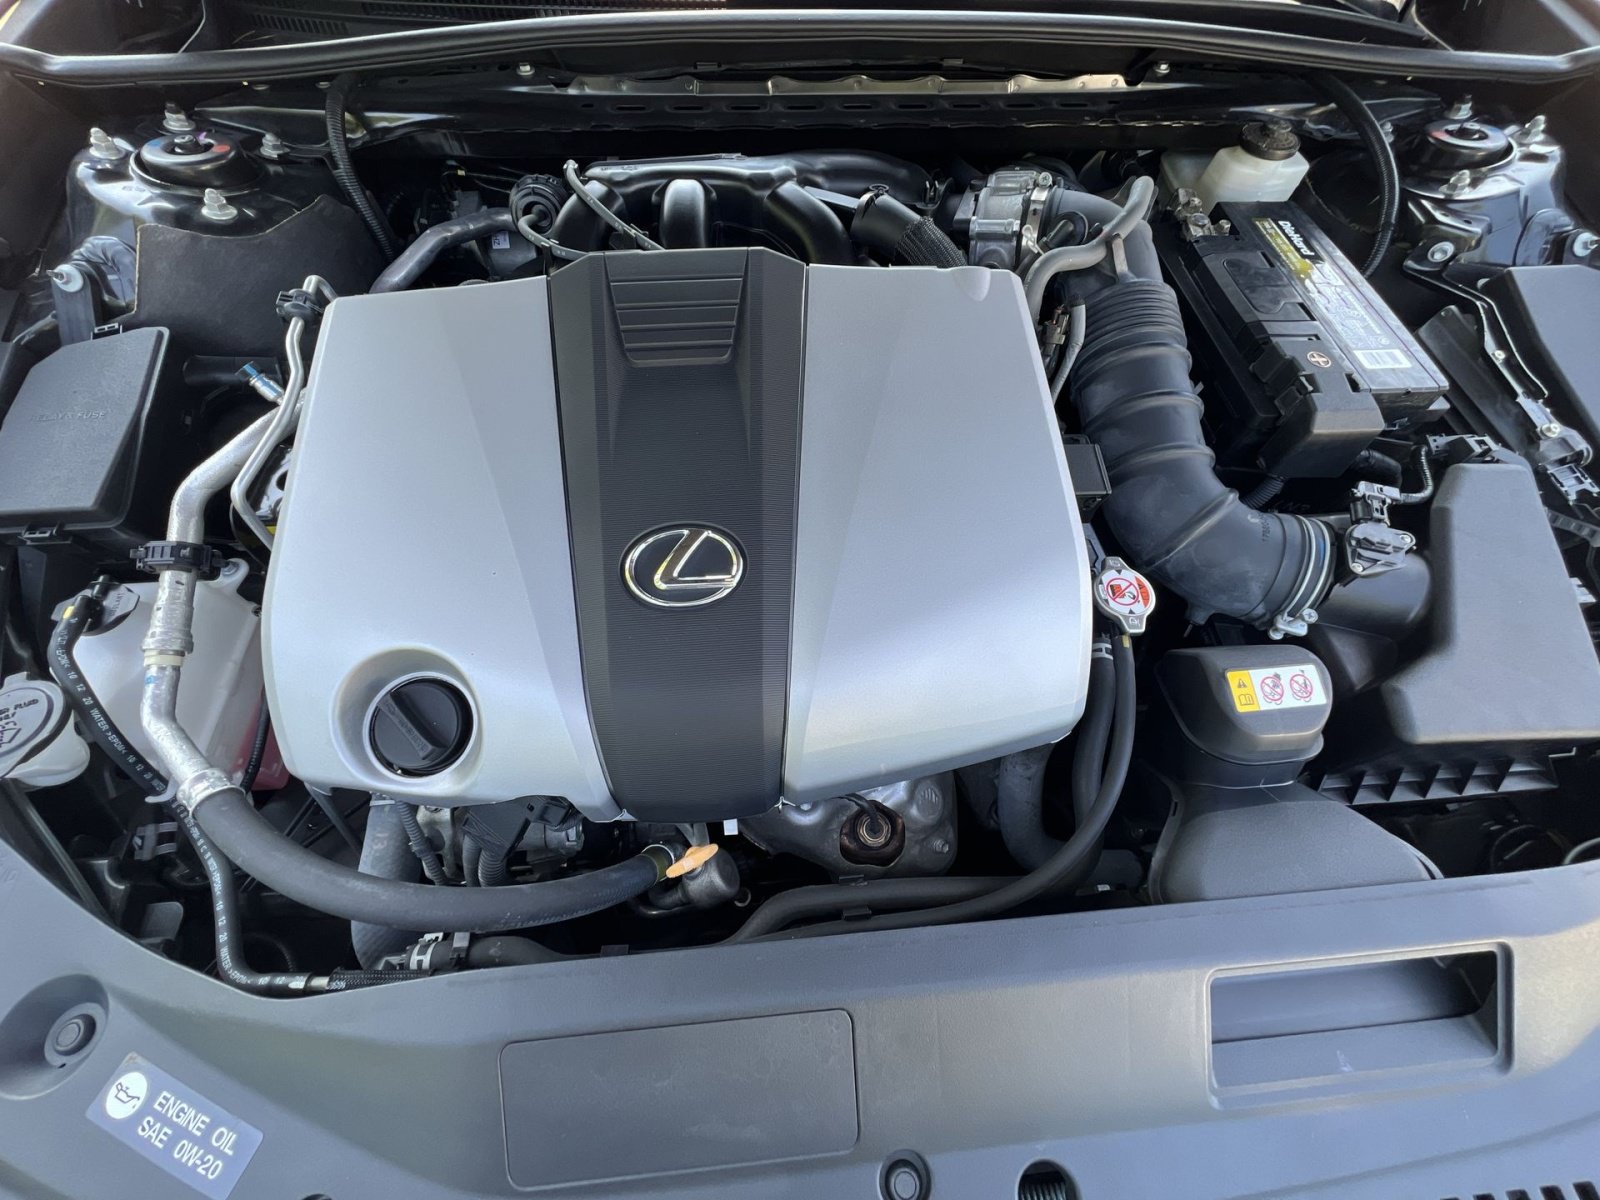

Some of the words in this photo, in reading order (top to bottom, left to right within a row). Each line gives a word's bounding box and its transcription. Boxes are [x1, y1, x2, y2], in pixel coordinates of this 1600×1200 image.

[1277, 220, 1315, 256] DieHard
[90, 707, 109, 732] WATER
[137, 1116, 172, 1149] SAE
[173, 1140, 224, 1180] 0W-20
[153, 1090, 211, 1137] ENGINE
[211, 1127, 238, 1156] OIL
